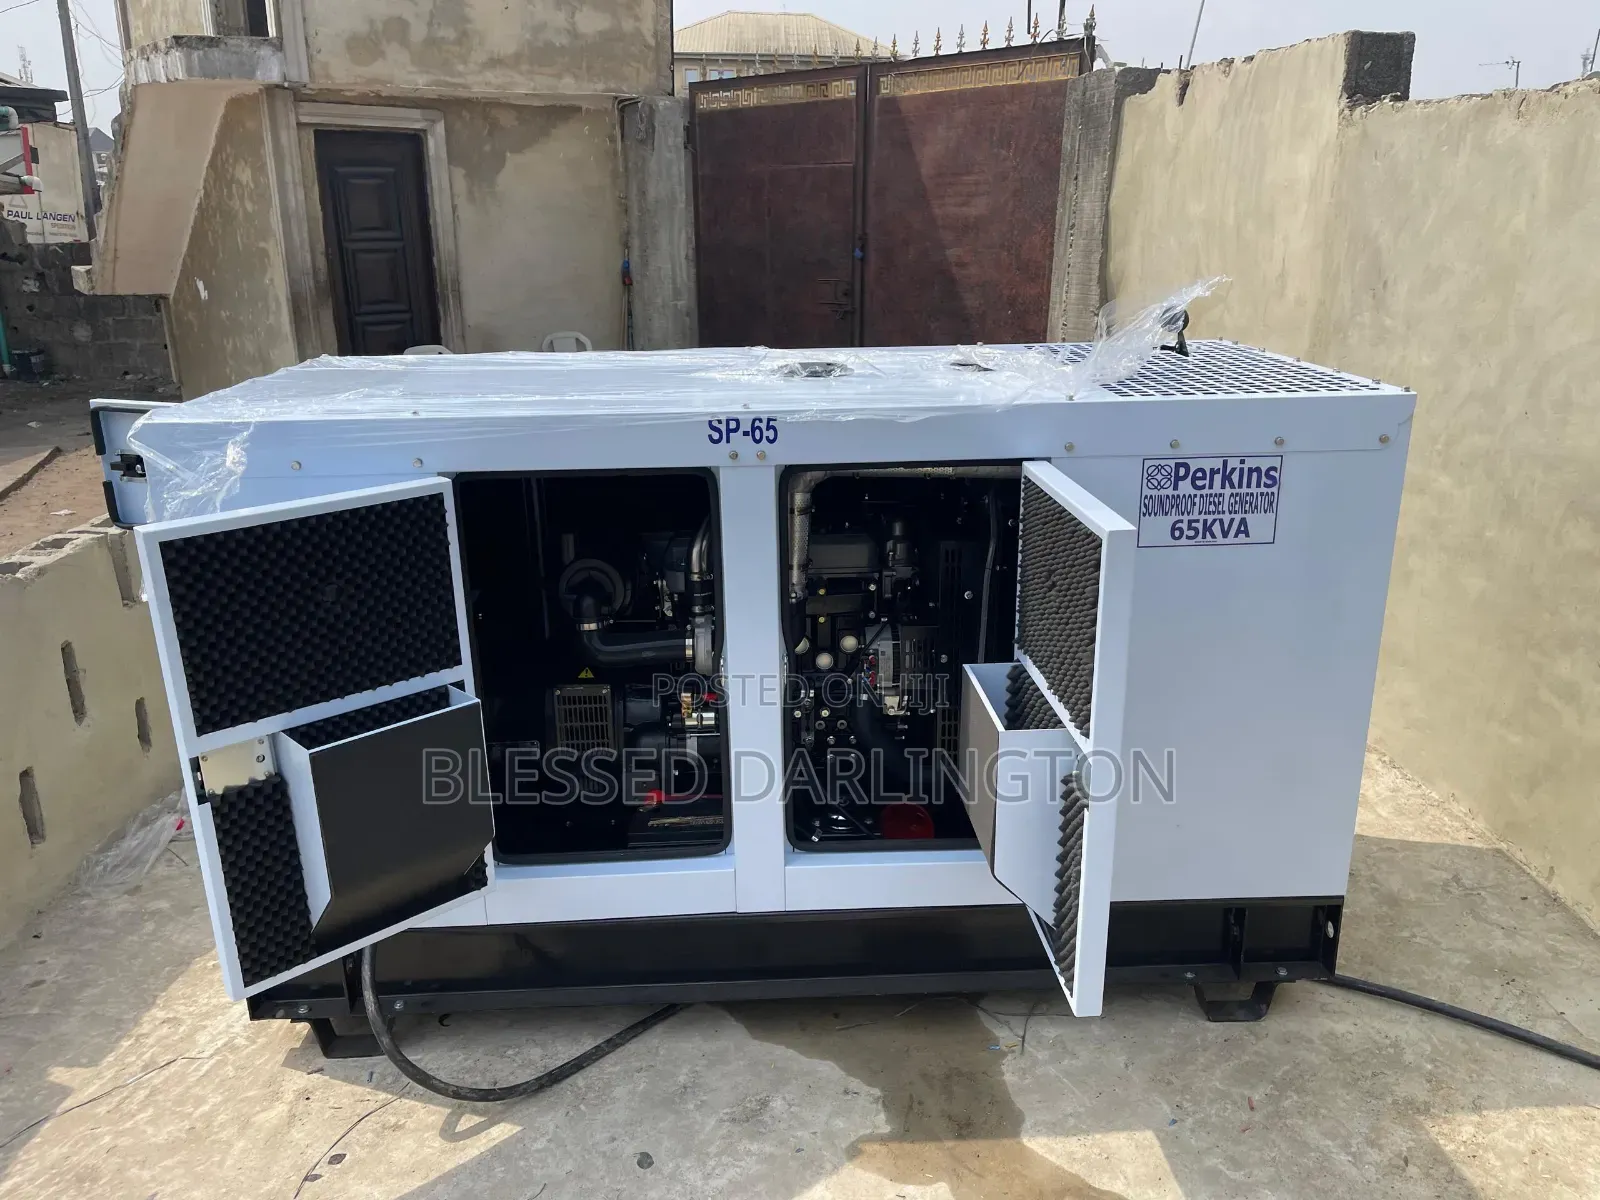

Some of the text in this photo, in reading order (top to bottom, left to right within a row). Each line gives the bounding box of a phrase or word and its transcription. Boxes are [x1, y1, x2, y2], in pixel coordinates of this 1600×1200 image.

[7, 210, 75, 222] PAUL LANGEN
[707, 416, 778, 445] SP-65
[1172, 458, 1279, 492] Perkins
[1142, 491, 1276, 518] SOUNDPROOF DIESEL GENERATOR
[1170, 516, 1251, 541] 65KVA
